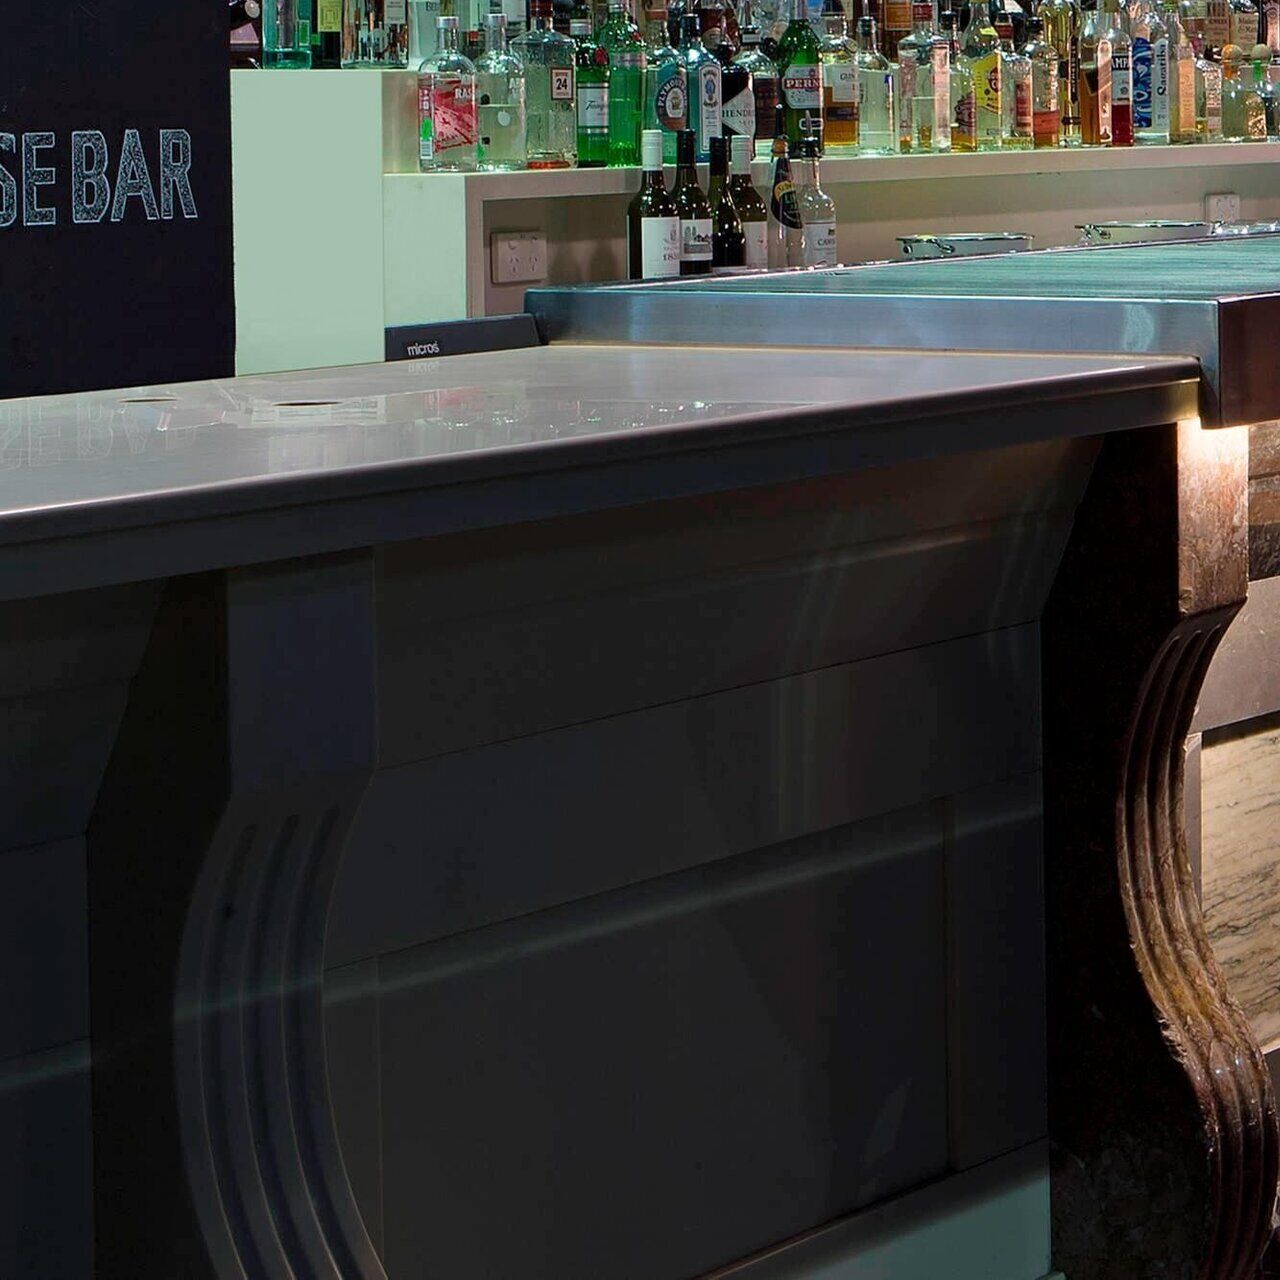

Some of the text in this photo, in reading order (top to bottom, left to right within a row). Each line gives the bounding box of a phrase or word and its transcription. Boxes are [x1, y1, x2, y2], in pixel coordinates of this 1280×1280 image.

[556, 78, 568, 91] 24
[71, 128, 199, 224] BAR
[406, 340, 440, 357] micros
